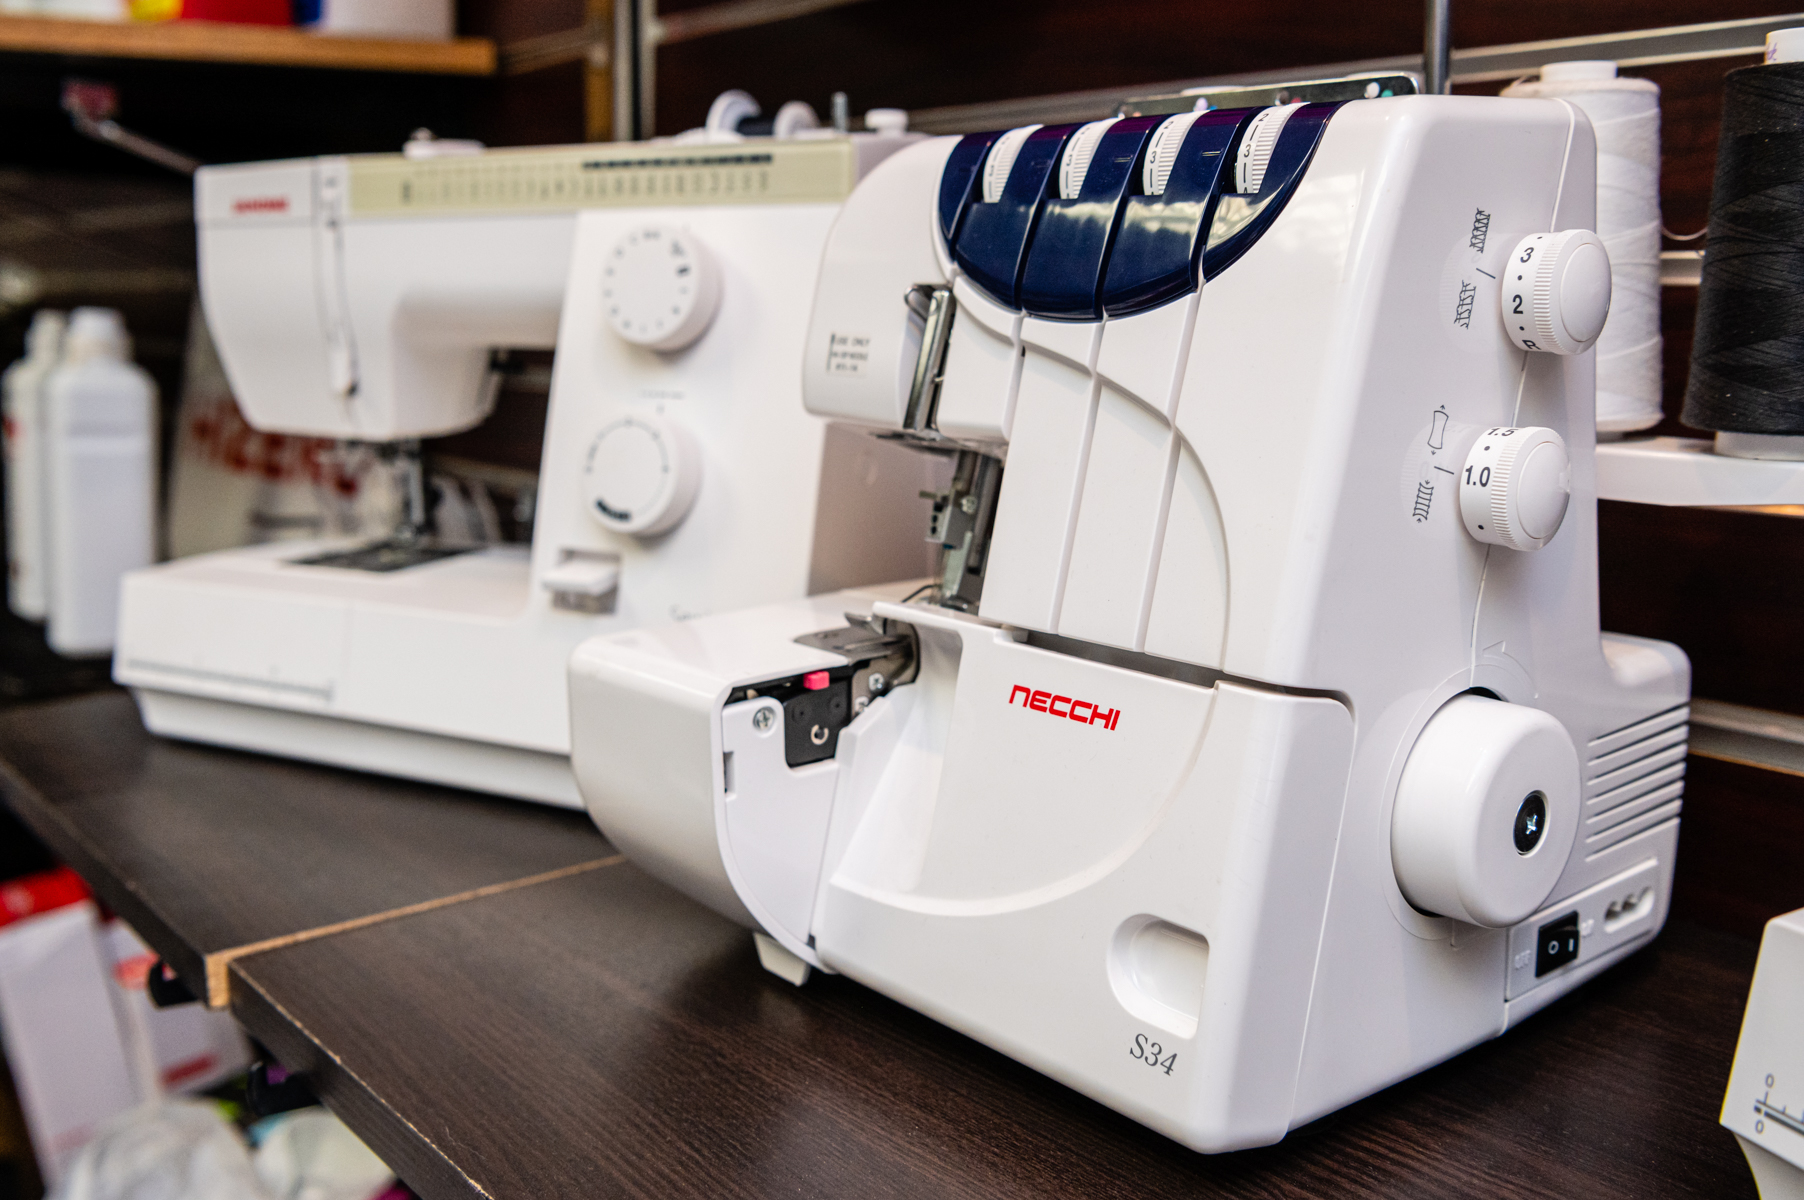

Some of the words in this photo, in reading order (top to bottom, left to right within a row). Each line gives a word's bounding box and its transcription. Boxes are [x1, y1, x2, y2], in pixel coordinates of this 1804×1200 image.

[1258, 113, 1270, 122] 2
[1149, 150, 1158, 164] 3
[1243, 143, 1252, 158] 3
[1520, 246, 1535, 263] 3
[1512, 294, 1524, 315] 2
[1521, 339, 1542, 351] R
[1487, 427, 1519, 437] 1.5
[1465, 465, 1491, 488] 1.0
[1008, 684, 1121, 731] NECCHI
[1129, 1033, 1178, 1077] S34
